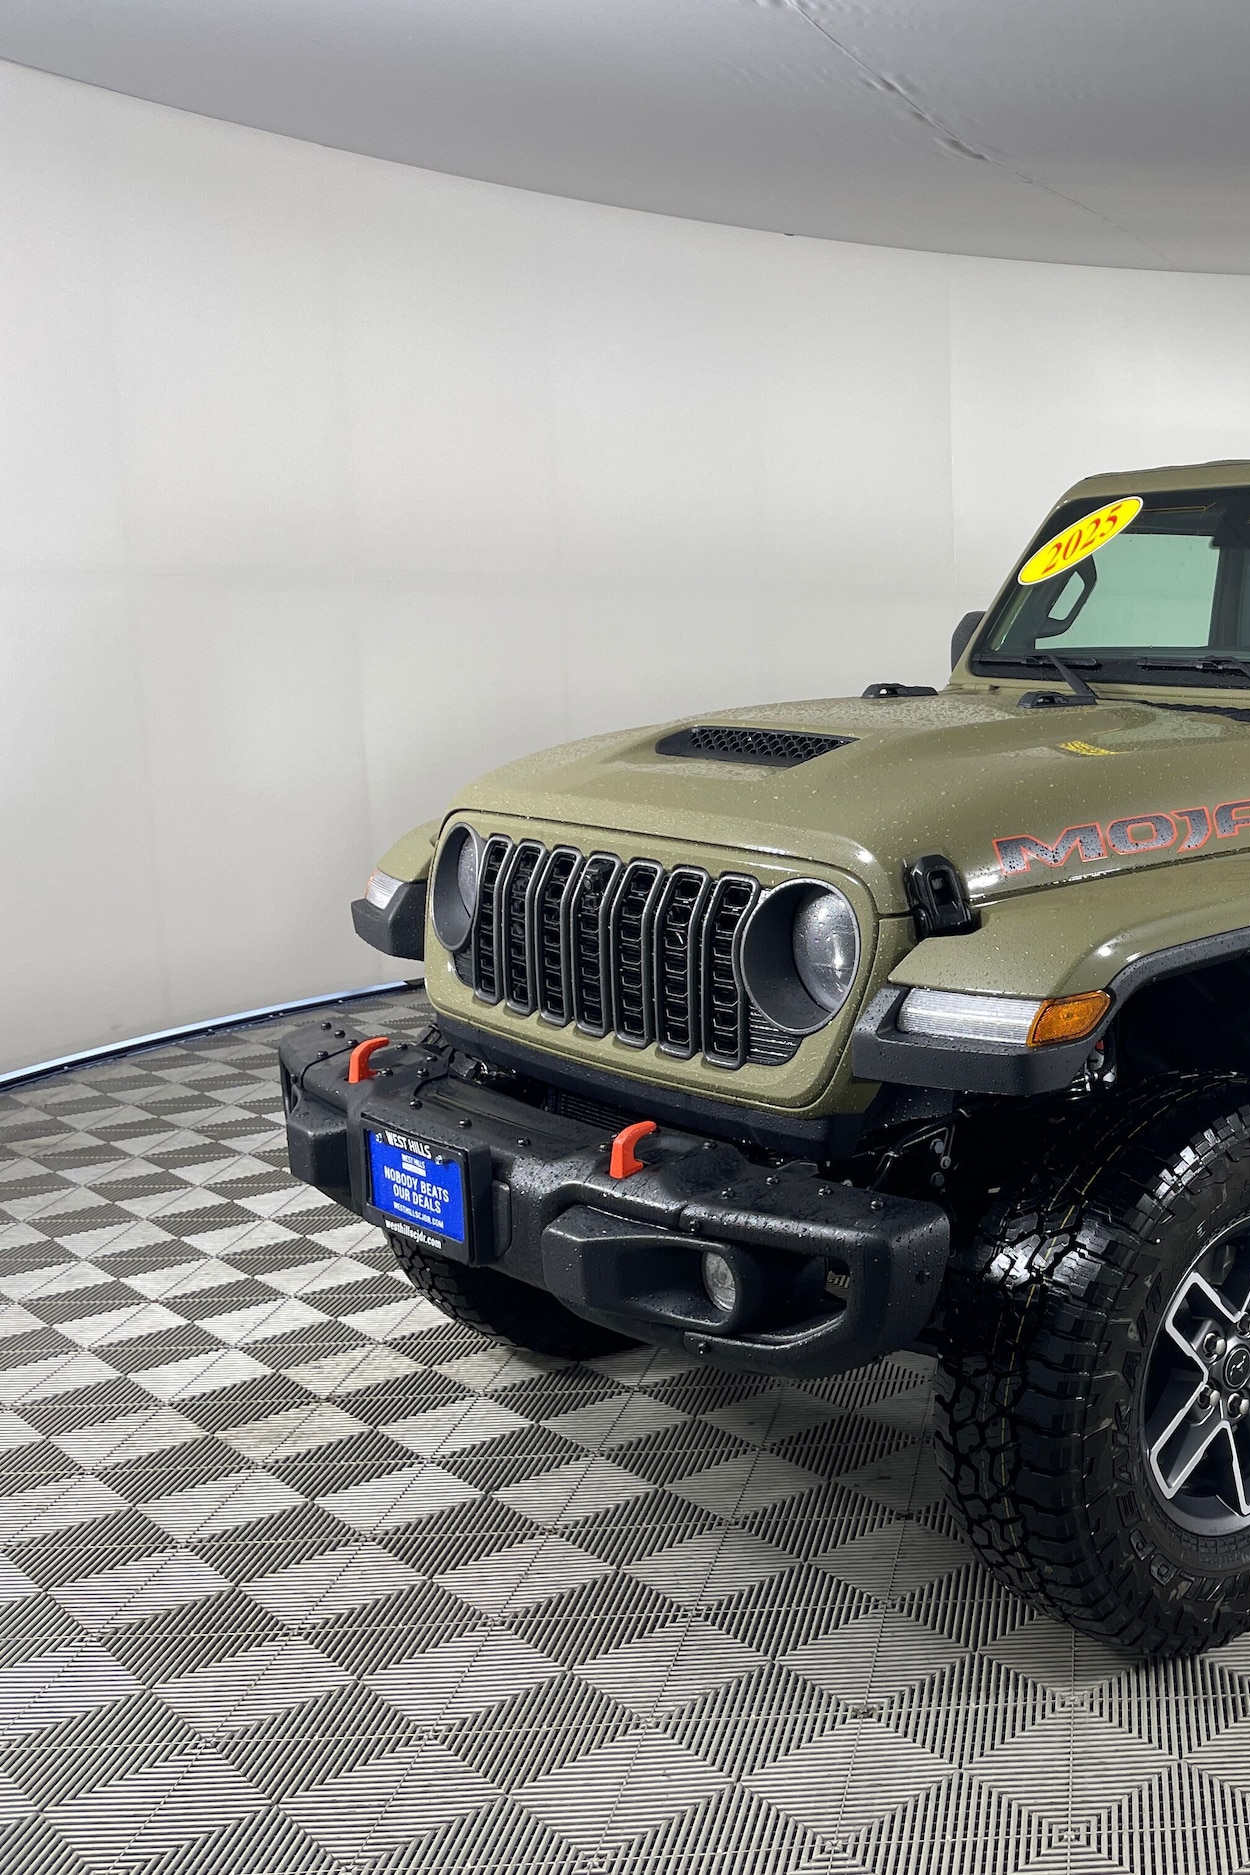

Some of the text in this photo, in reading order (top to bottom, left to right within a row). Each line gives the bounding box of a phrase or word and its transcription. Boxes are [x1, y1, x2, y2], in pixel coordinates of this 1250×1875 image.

[1041, 503, 1122, 575] 2025
[385, 1131, 432, 1159] WEST HILLS
[384, 1165, 450, 1203] NOBODY BEATS
[393, 1183, 442, 1214] OUR DEALS
[385, 1220, 442, 1249] westhillscjdr.com
